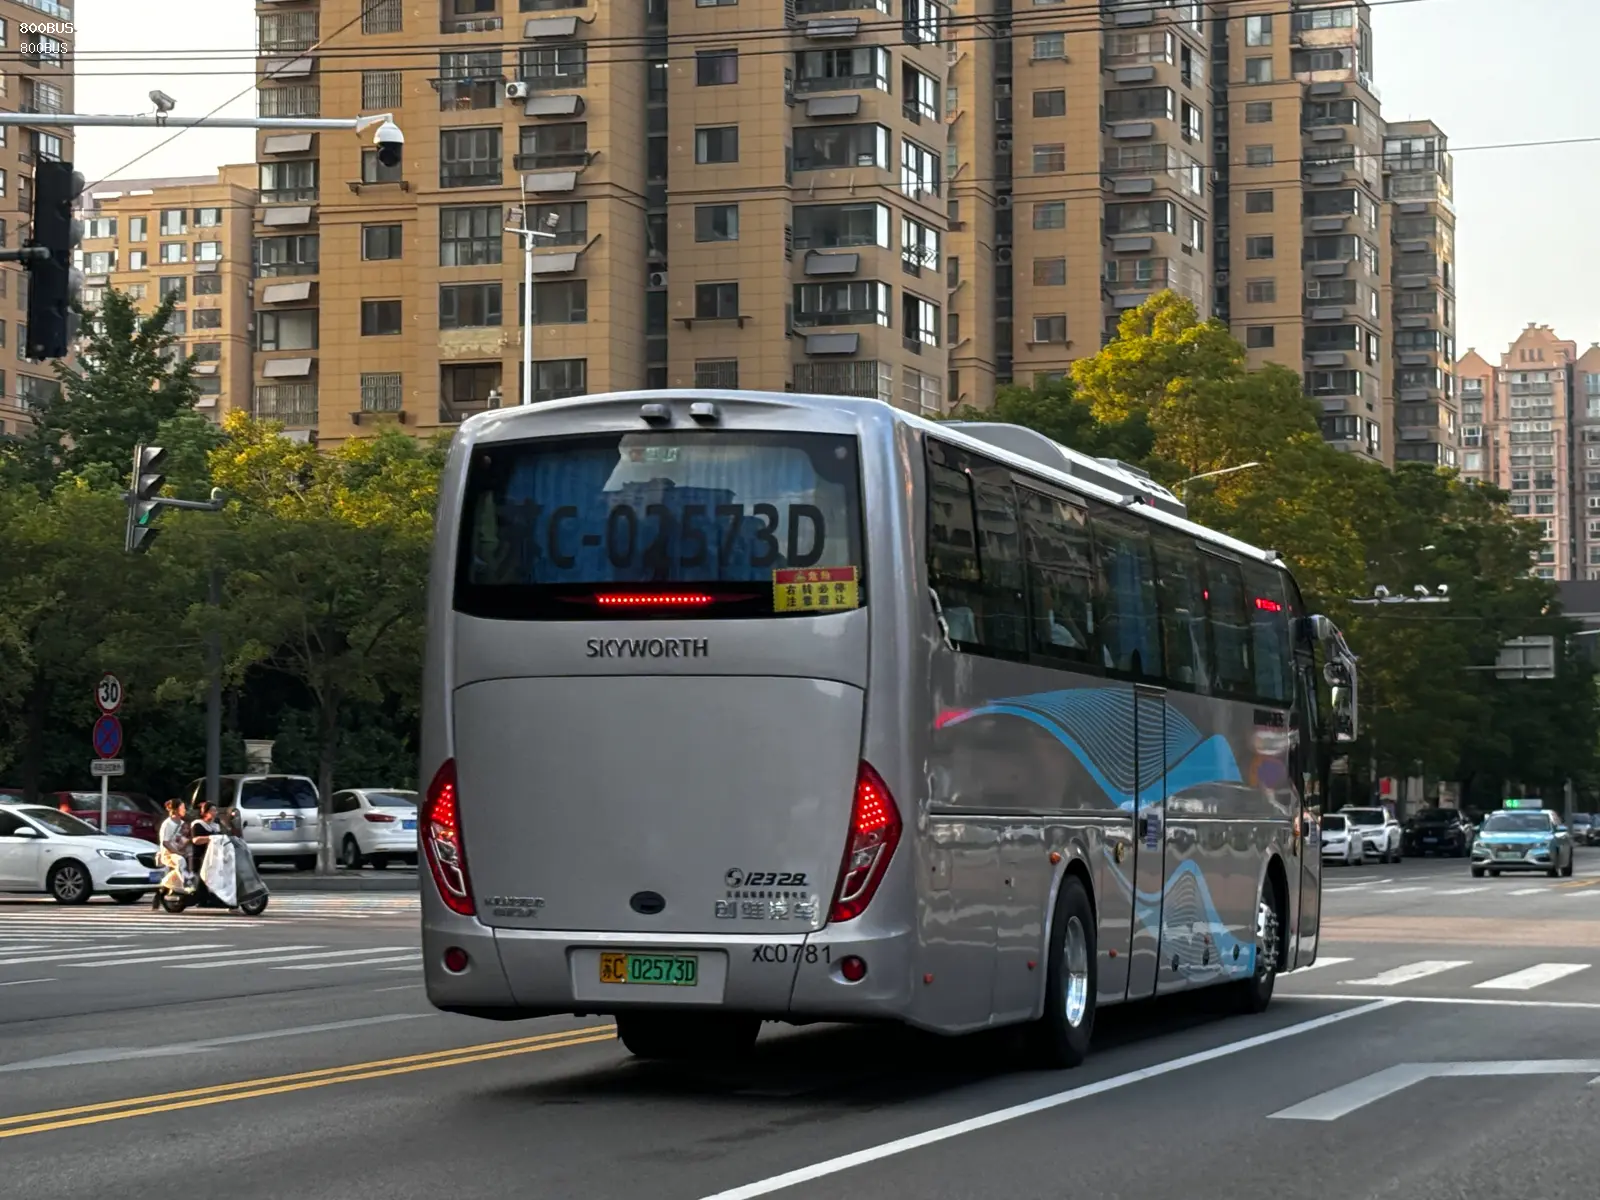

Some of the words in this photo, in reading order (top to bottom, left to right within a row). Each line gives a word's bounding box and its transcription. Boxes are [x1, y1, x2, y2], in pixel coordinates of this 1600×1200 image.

[586, 637, 708, 658] SKYWORTH
[101, 682, 118, 702] 30
[744, 872, 808, 887] 12328
[752, 944, 831, 964] XC0781
